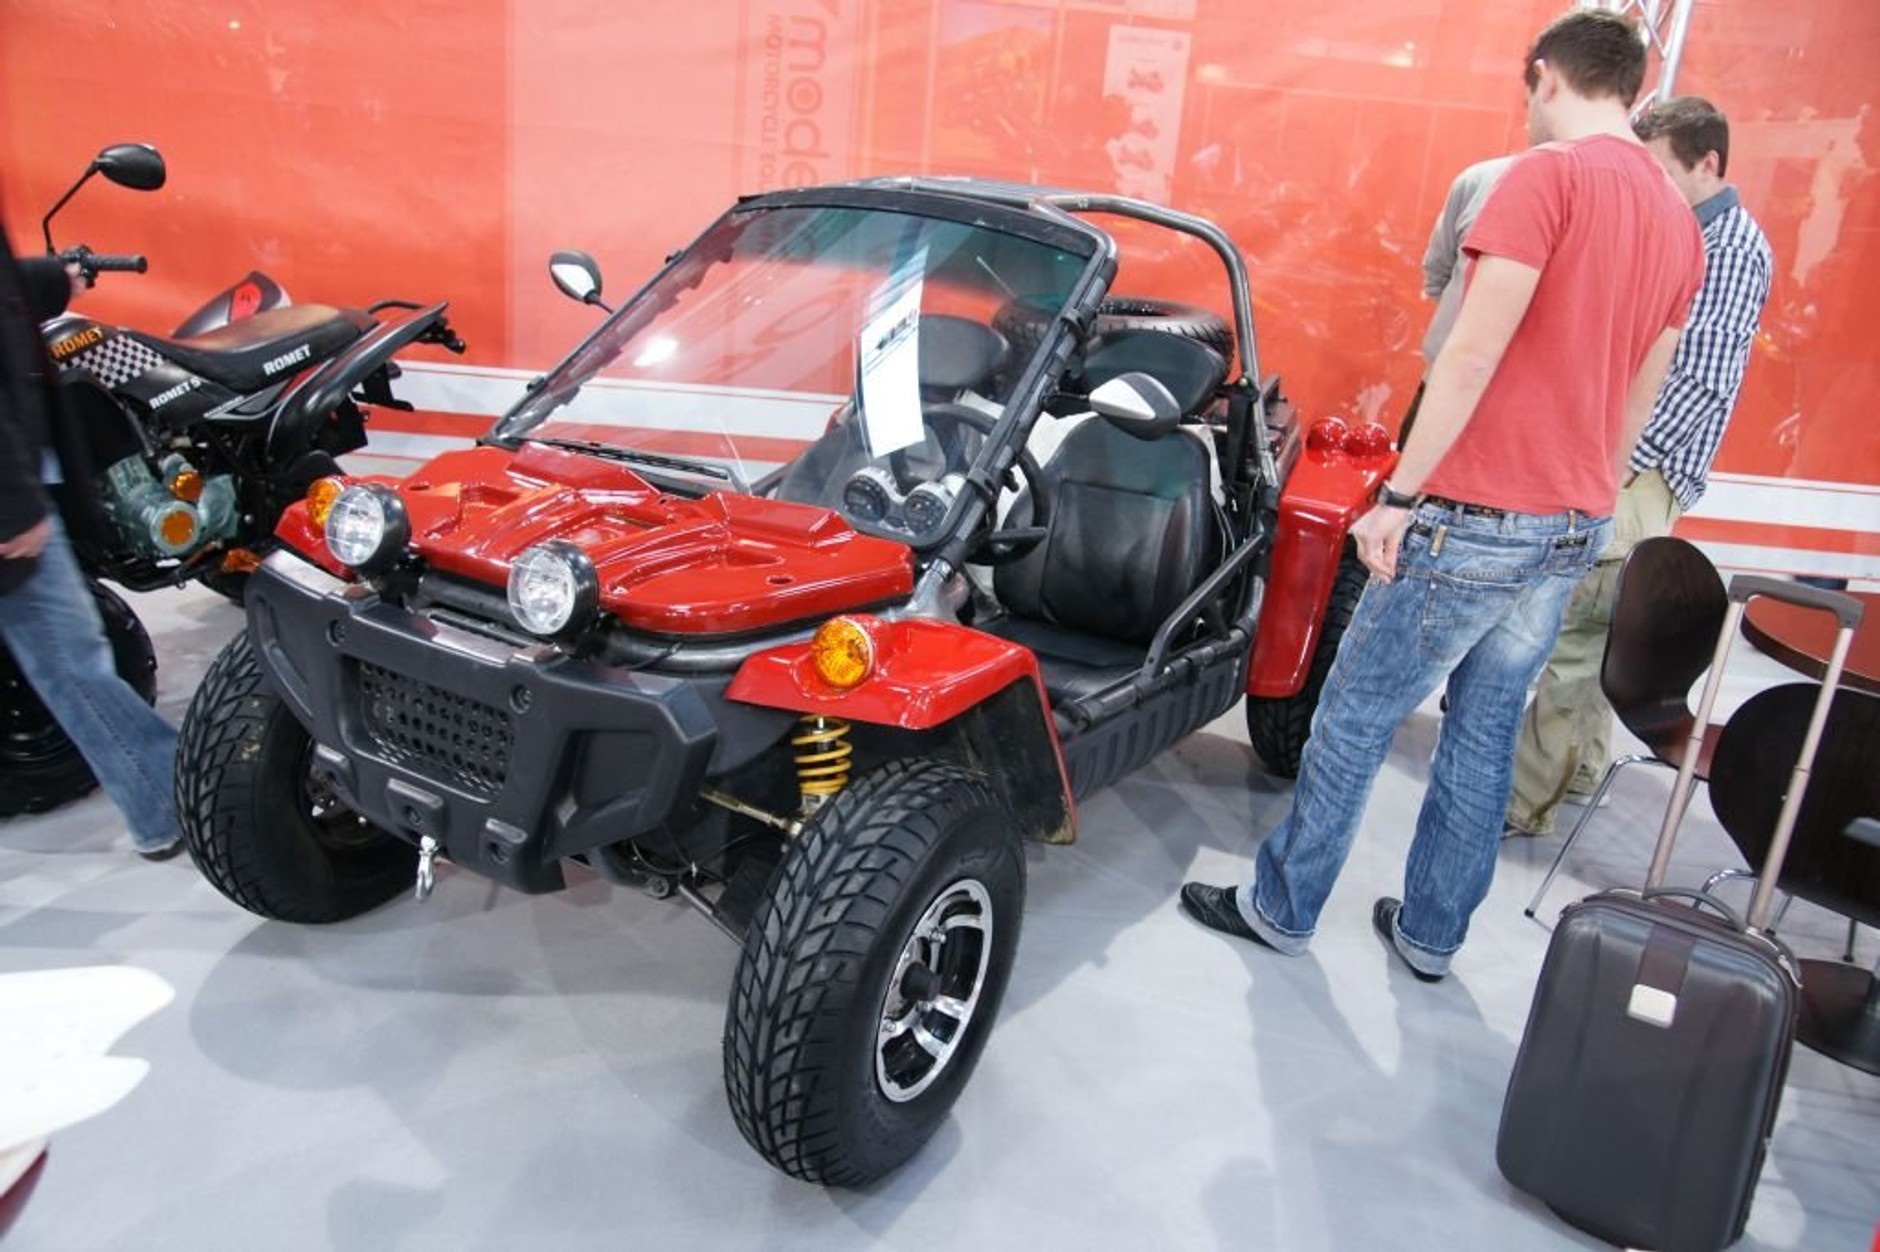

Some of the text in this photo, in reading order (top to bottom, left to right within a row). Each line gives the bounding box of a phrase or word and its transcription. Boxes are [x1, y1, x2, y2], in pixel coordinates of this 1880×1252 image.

[784, 15, 829, 187] mode
[50, 326, 103, 358] ROMET
[263, 343, 311, 376] ROMET
[149, 381, 191, 410] ROMET
